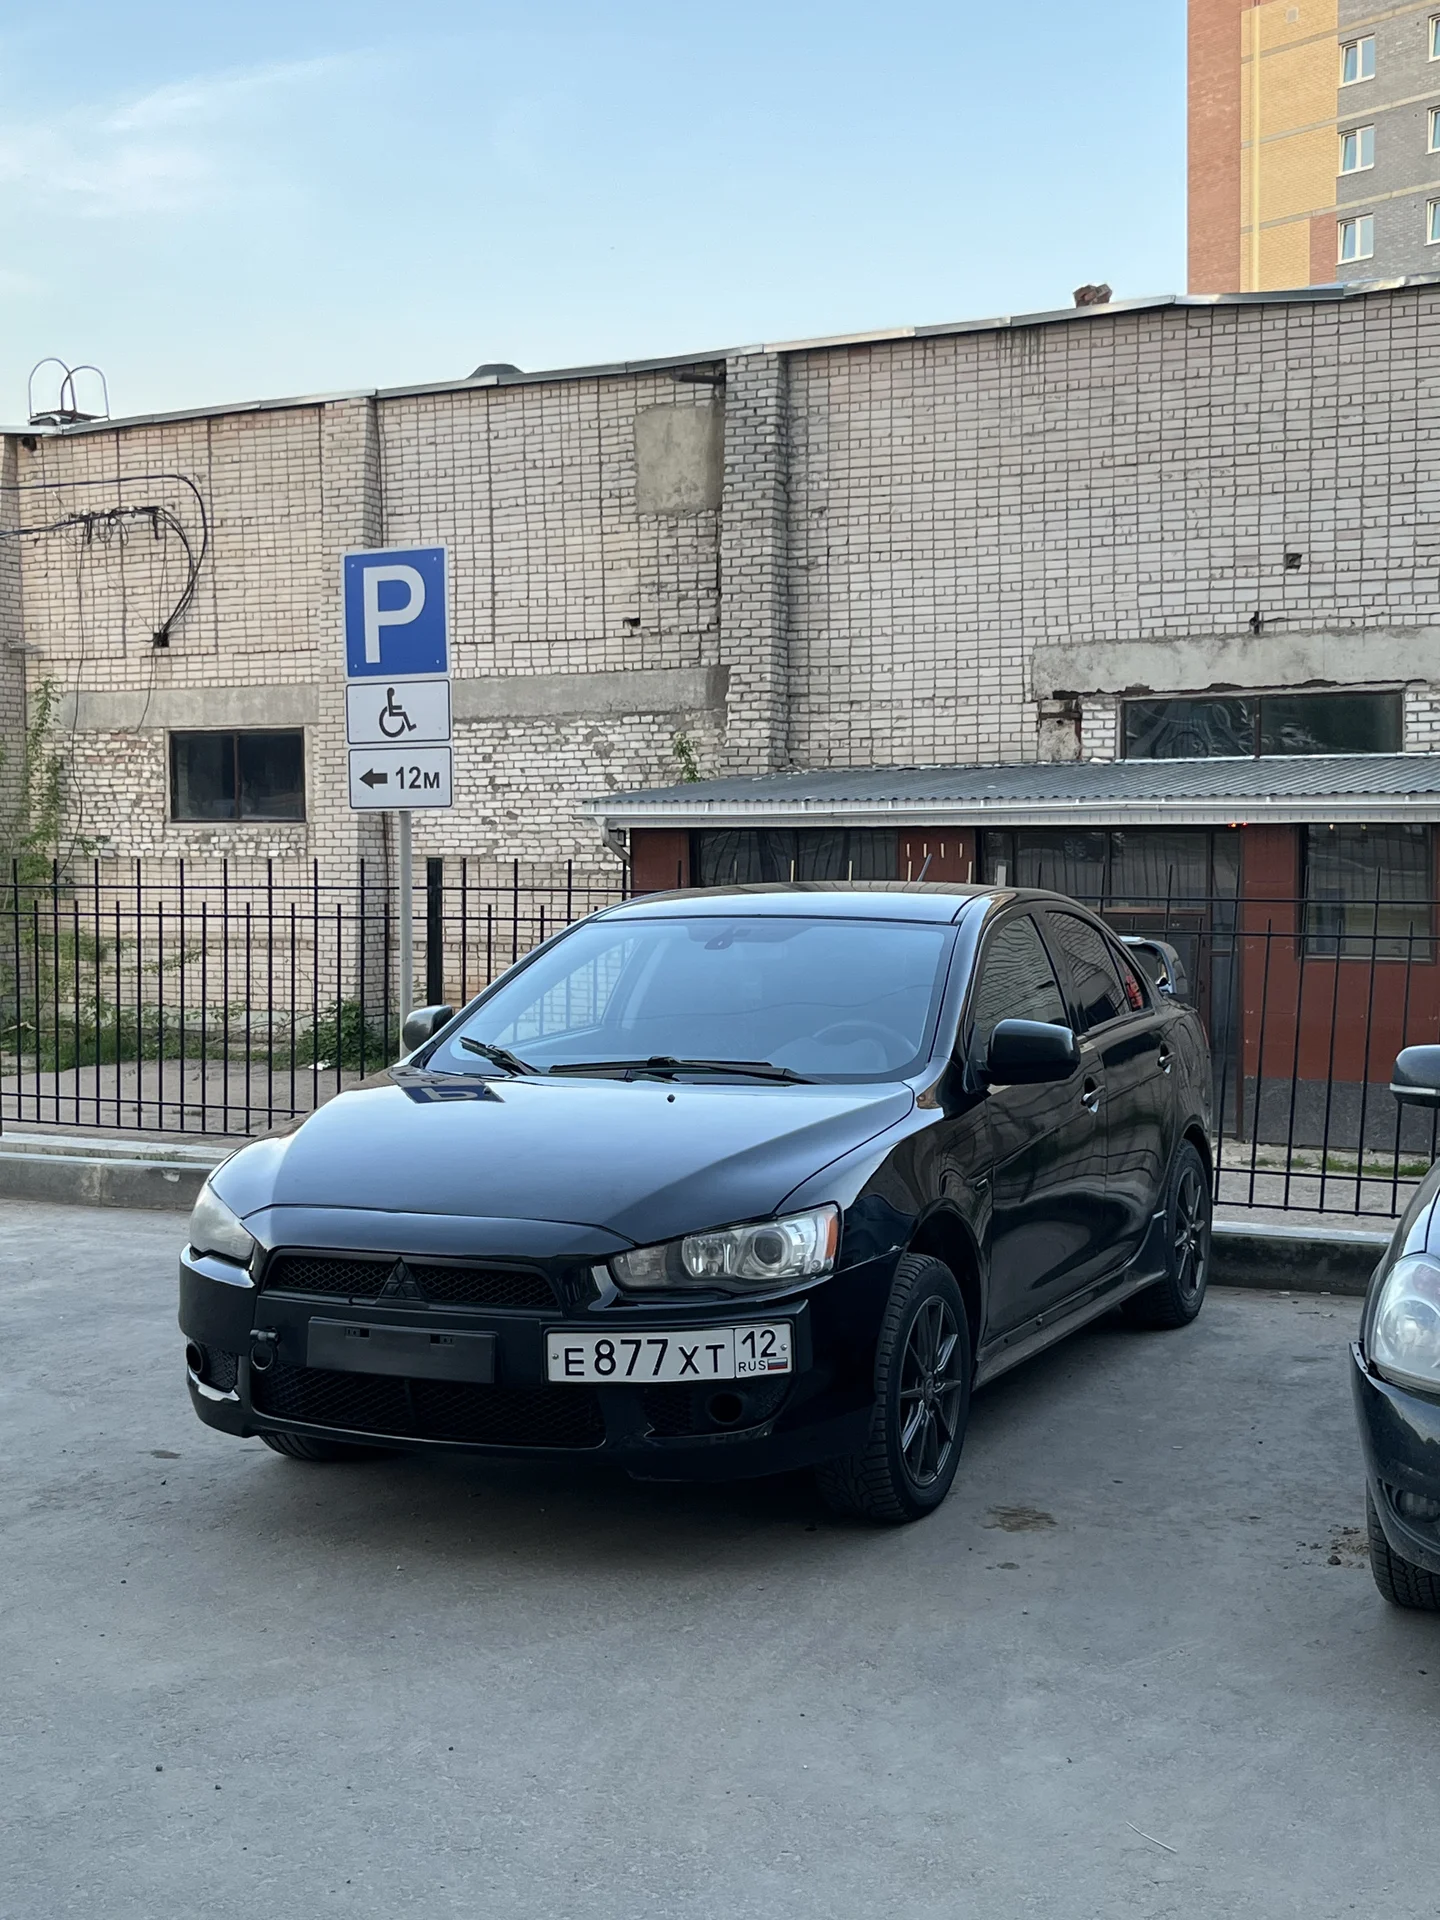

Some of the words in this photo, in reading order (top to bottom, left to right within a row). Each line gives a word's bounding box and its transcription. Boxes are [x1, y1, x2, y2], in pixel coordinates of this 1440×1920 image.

[363, 564, 425, 664] P
[741, 1329, 777, 1358] 12
[738, 1360, 766, 1372] RUS
